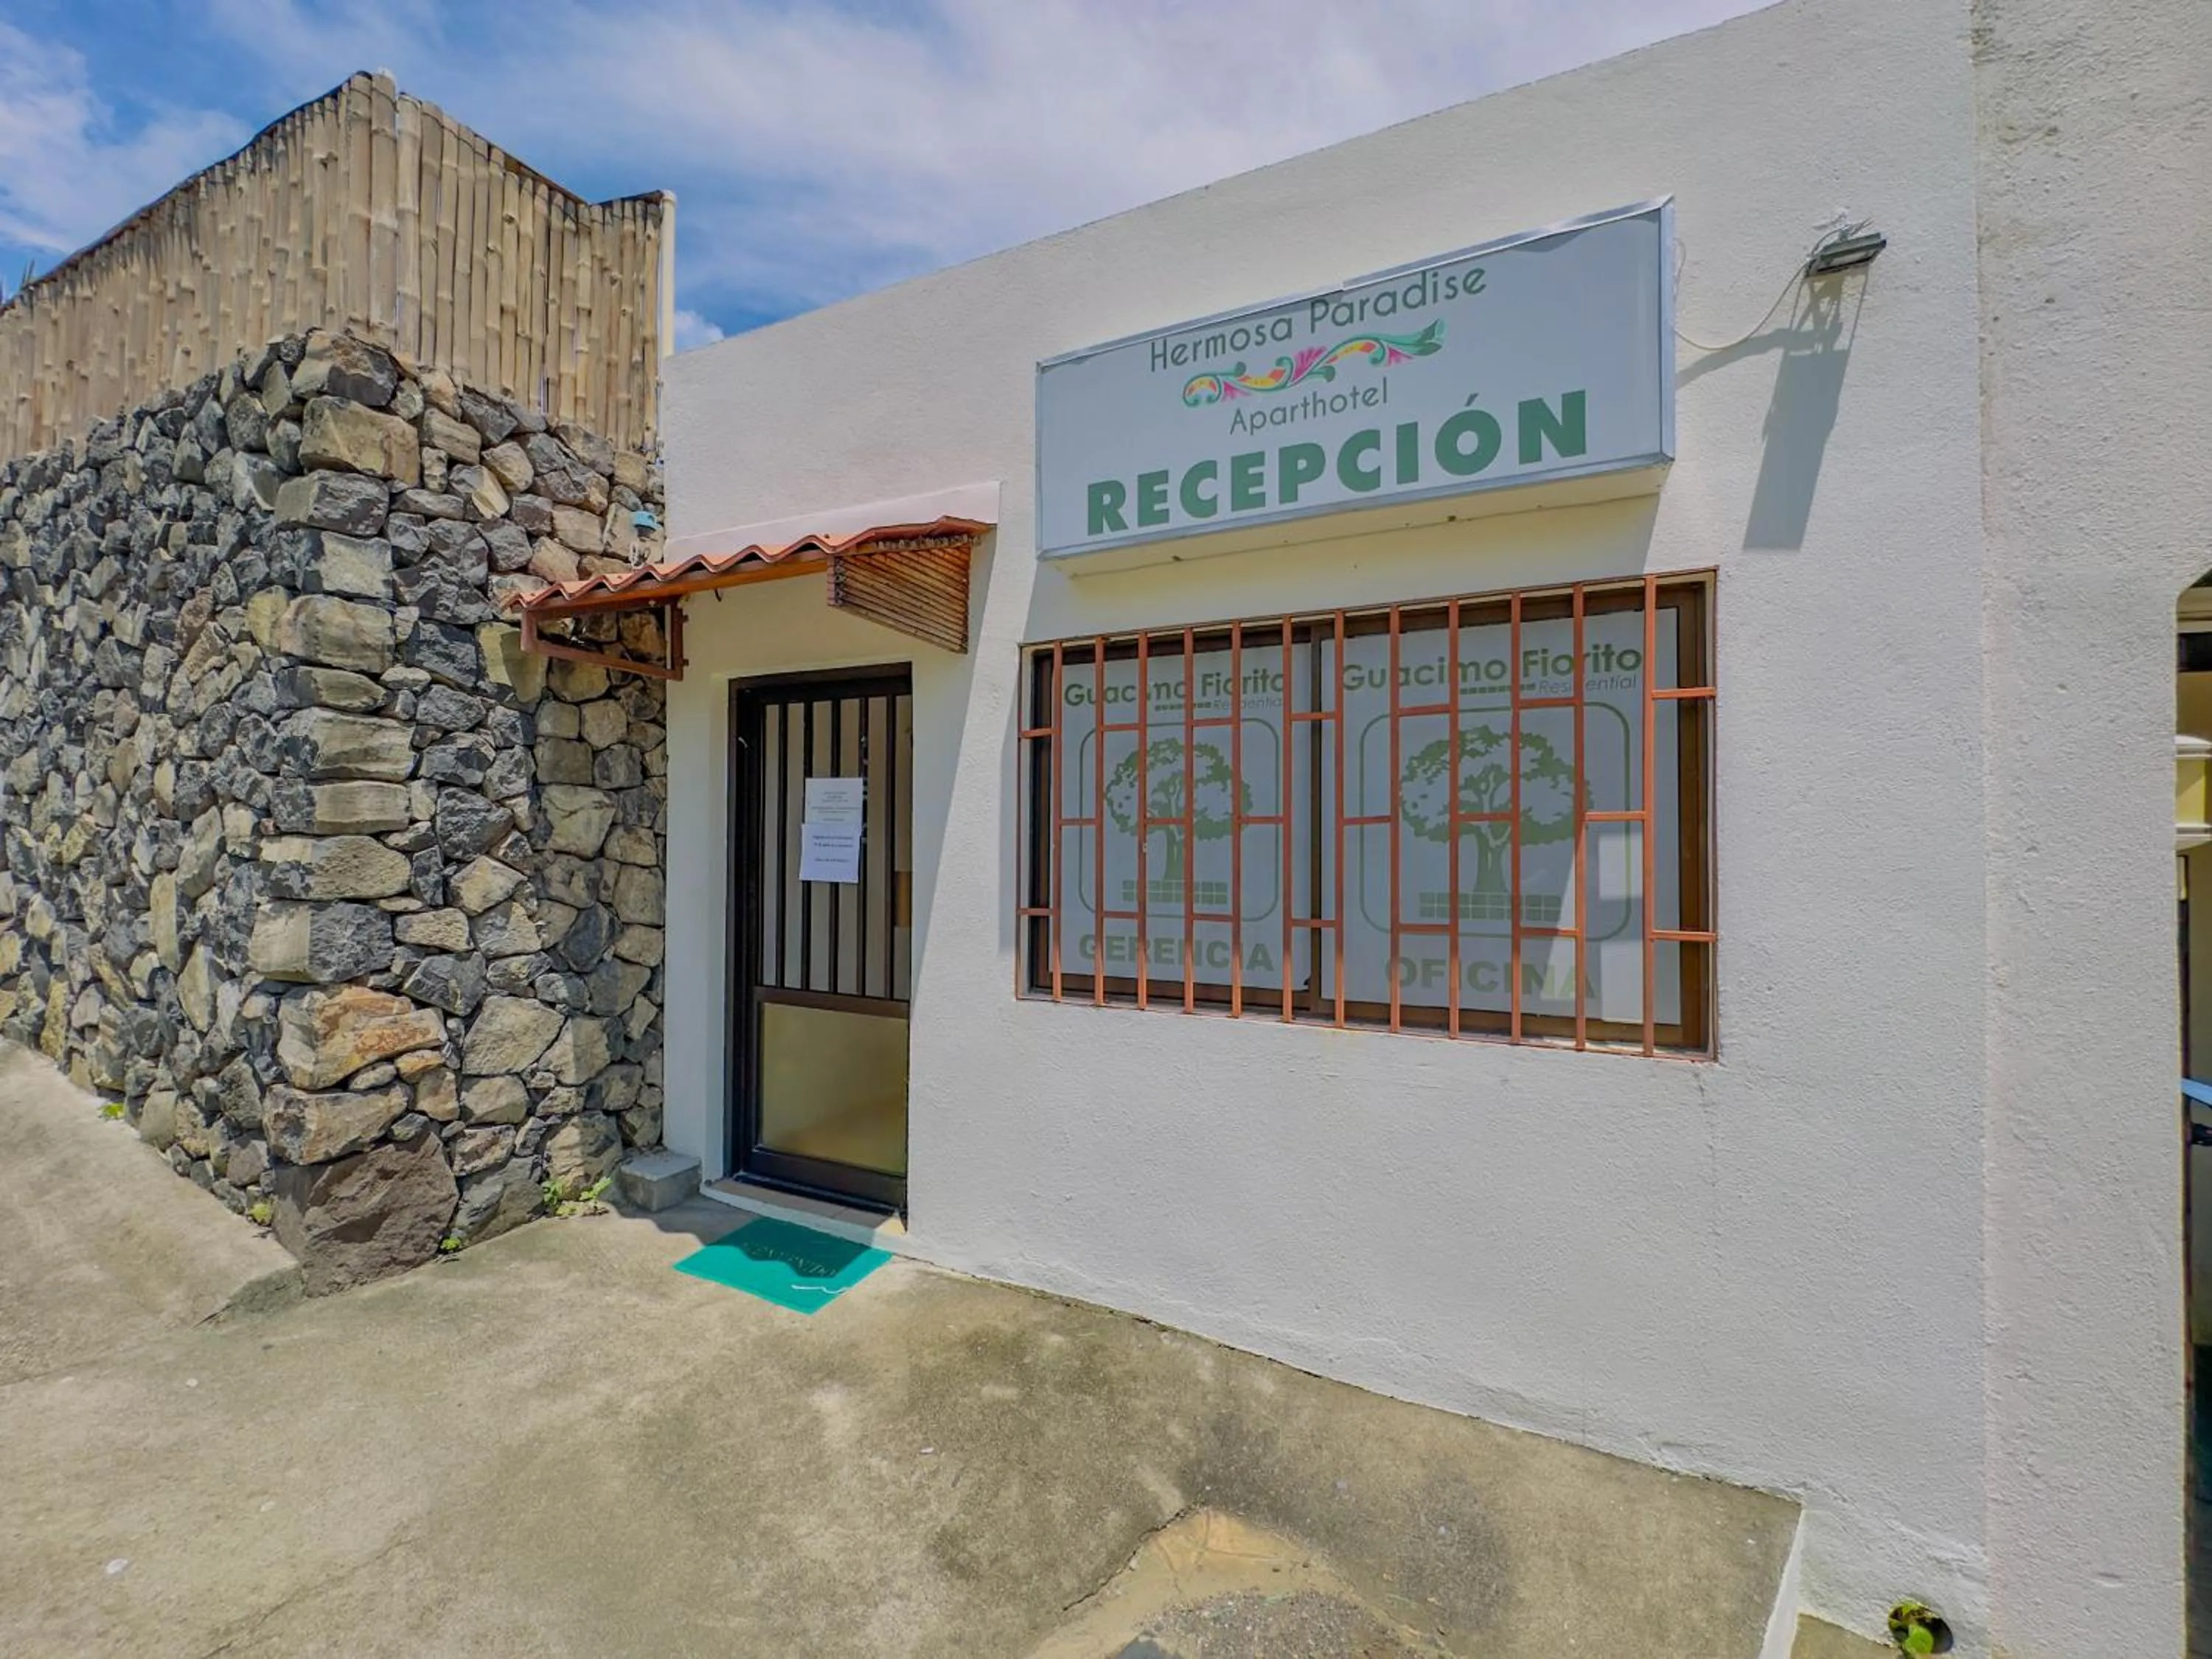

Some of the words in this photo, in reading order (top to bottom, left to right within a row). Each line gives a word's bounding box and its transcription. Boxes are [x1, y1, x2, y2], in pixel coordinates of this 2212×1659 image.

[1150, 315, 1293, 372] Hermosa
[1310, 267, 1488, 333] Paradise
[1229, 378, 1388, 435] Aparthotel
[1088, 389, 1587, 536] RECEPCIÓN
[1065, 680, 1189, 706] Guacmo
[1538, 674, 1637, 695] Resiential
[1079, 933, 1275, 972] GERENCA
[1385, 956, 1596, 998] OFCINA
